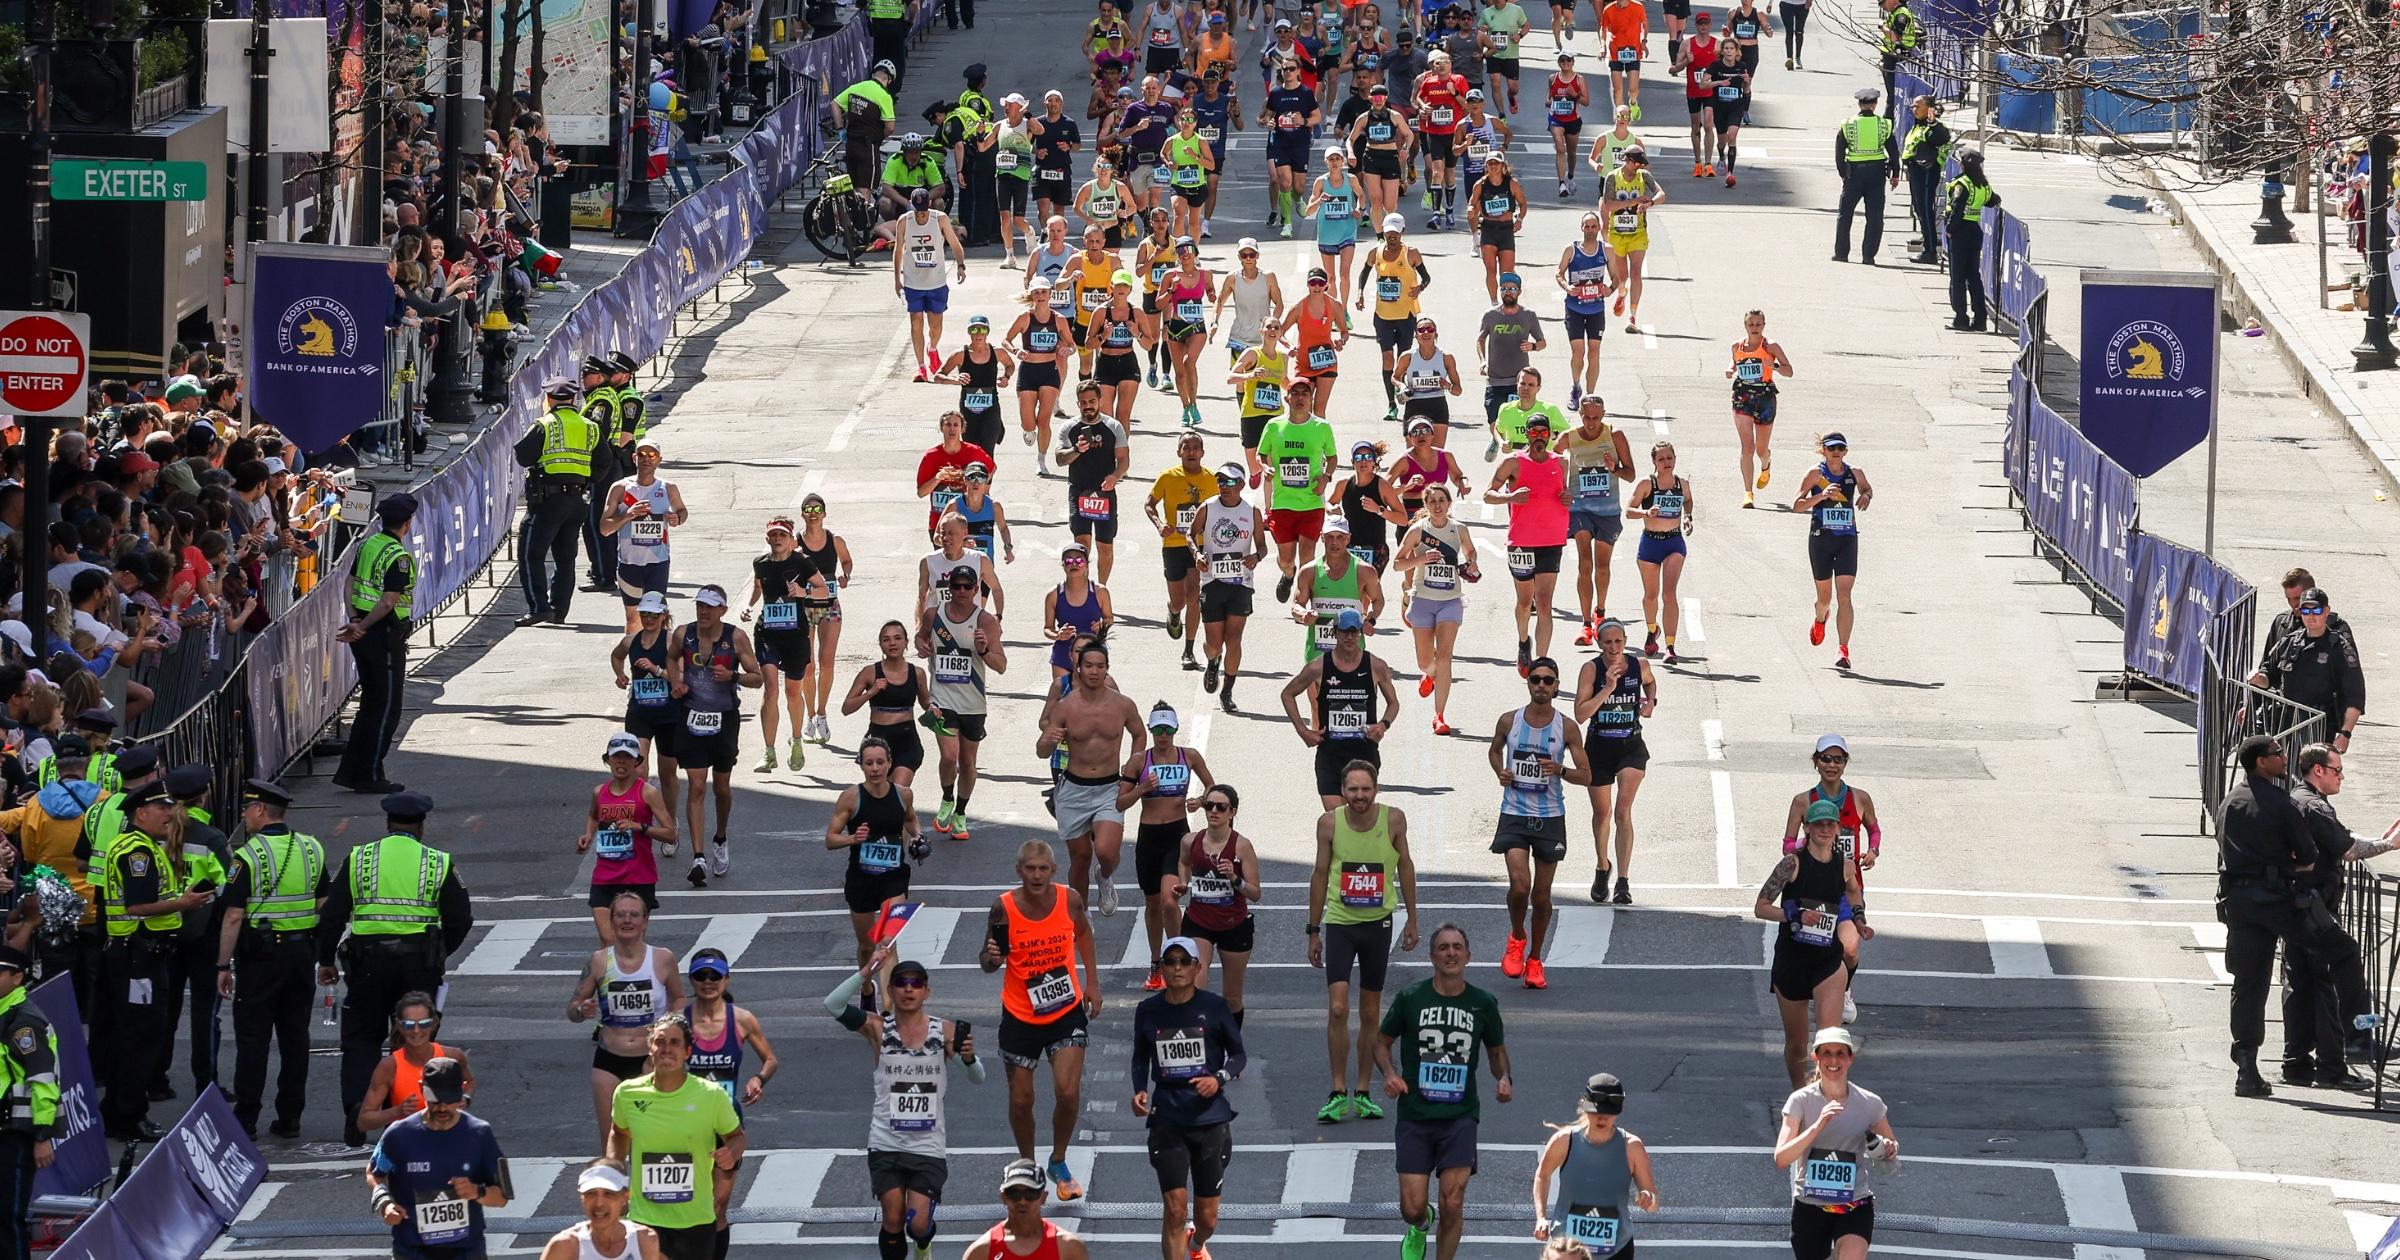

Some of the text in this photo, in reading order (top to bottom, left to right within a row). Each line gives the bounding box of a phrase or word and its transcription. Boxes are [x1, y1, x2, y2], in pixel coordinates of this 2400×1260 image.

[84, 169, 187, 198] EXETER ST
[1051, 291, 1068, 301] 4121
[280, 298, 356, 350] THE BOSTON MARATHON
[1, 338, 72, 353] DO NOT
[1033, 332, 1056, 344] 16372
[2108, 322, 2182, 374] THE BOSTON MARATHON
[266, 362, 356, 375] BANK OF AMERICA
[1738, 364, 1761, 377] 17188
[8, 377, 63, 391] ENTER
[2095, 387, 2184, 398] BANK OF AMERICA
[1285, 440, 1305, 450] DIEGO
[1281, 465, 1308, 478] 12035
[1582, 474, 1608, 487] 19973
[1825, 509, 1851, 522] 18761
[634, 523, 662, 535] 13229
[1220, 529, 1249, 540] MEXICO
[1508, 553, 1533, 565] 13710
[1215, 561, 1241, 574] 12143
[1427, 565, 1454, 578] 13260
[766, 604, 793, 617] 16171
[939, 656, 969, 671] 11683
[635, 679, 665, 695] 16424
[1604, 692, 1636, 706] Mairi
[691, 711, 719, 727] 15826
[1332, 713, 1362, 726] 12051
[1153, 766, 1184, 781] 17217
[1515, 762, 1541, 778] 1089
[863, 845, 897, 863] 17578
[255, 846, 271, 897] BOSTON
[360, 841, 372, 896] BOSTON
[426, 849, 439, 900] POLICE
[1347, 875, 1378, 891] 7544
[1018, 934, 1067, 950] BJM's 2024
[1028, 946, 1062, 959] WORLD
[1033, 979, 1070, 1004] 14395
[612, 993, 650, 1010] 14694
[1419, 1006, 1474, 1033] CELTICS
[1161, 1042, 1201, 1060] 13090
[1418, 1028, 1473, 1062] 33
[1424, 1066, 1463, 1084] 16201
[898, 1096, 930, 1112] 8478
[647, 1166, 690, 1185] 11207
[1810, 1162, 1852, 1183] 19298
[421, 1202, 465, 1226] 12568
[1571, 1217, 1614, 1239] 16225
